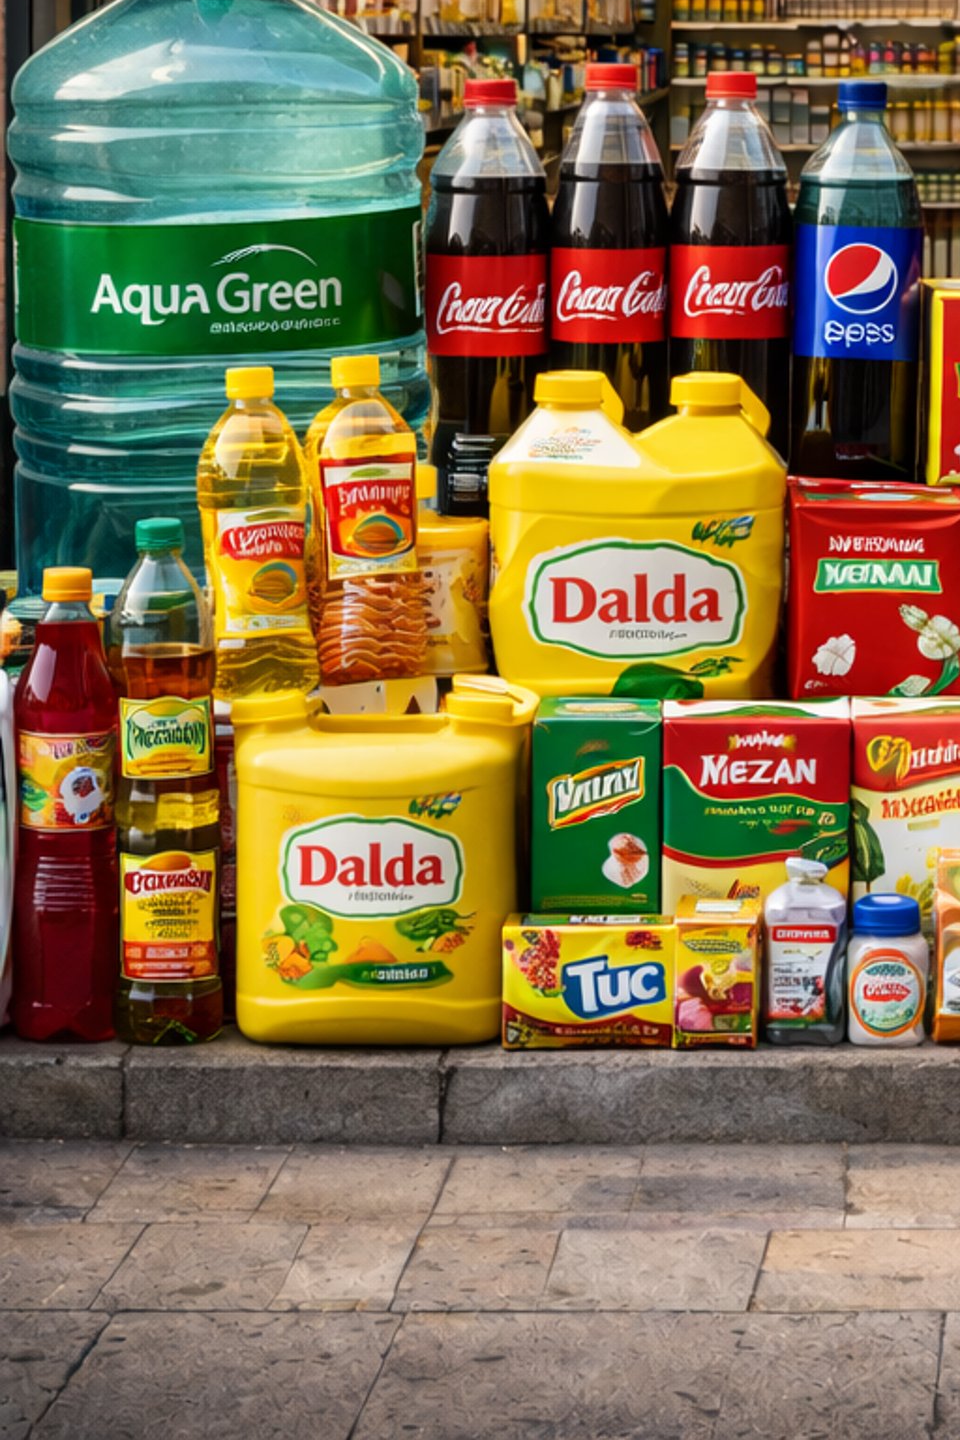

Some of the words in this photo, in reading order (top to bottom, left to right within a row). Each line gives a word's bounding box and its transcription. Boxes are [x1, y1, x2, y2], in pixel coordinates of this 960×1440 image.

[216, 273, 342, 314] Green
[549, 573, 723, 624] Dalda
[297, 842, 445, 888] Dalda
